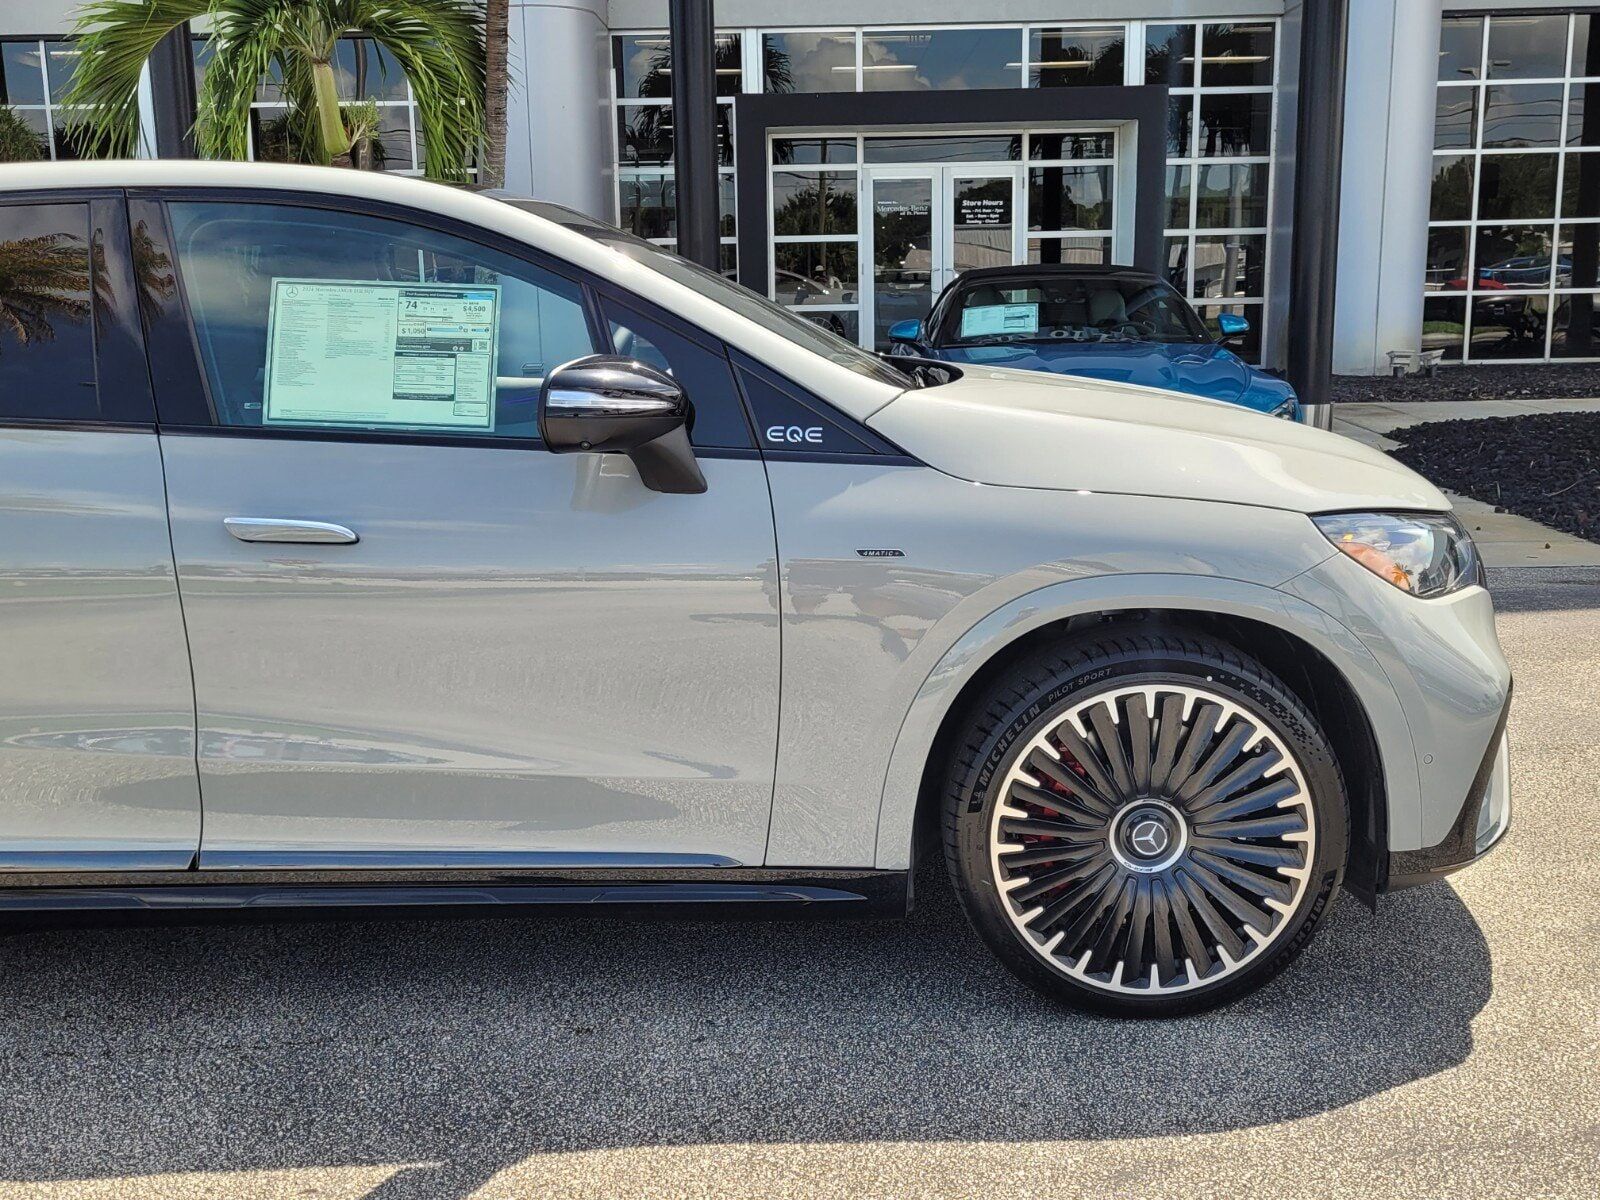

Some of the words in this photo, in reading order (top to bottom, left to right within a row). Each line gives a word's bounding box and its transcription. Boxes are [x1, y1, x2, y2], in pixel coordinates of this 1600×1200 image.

[877, 204, 929, 212] Mercedes-Benz
[962, 199, 982, 207] Store
[405, 300, 418, 310] 74
[766, 425, 823, 443] EQE
[978, 702, 1041, 787] MICHELIN
[1048, 683, 1075, 702] PILOT
[1077, 667, 1112, 685] SPORT
